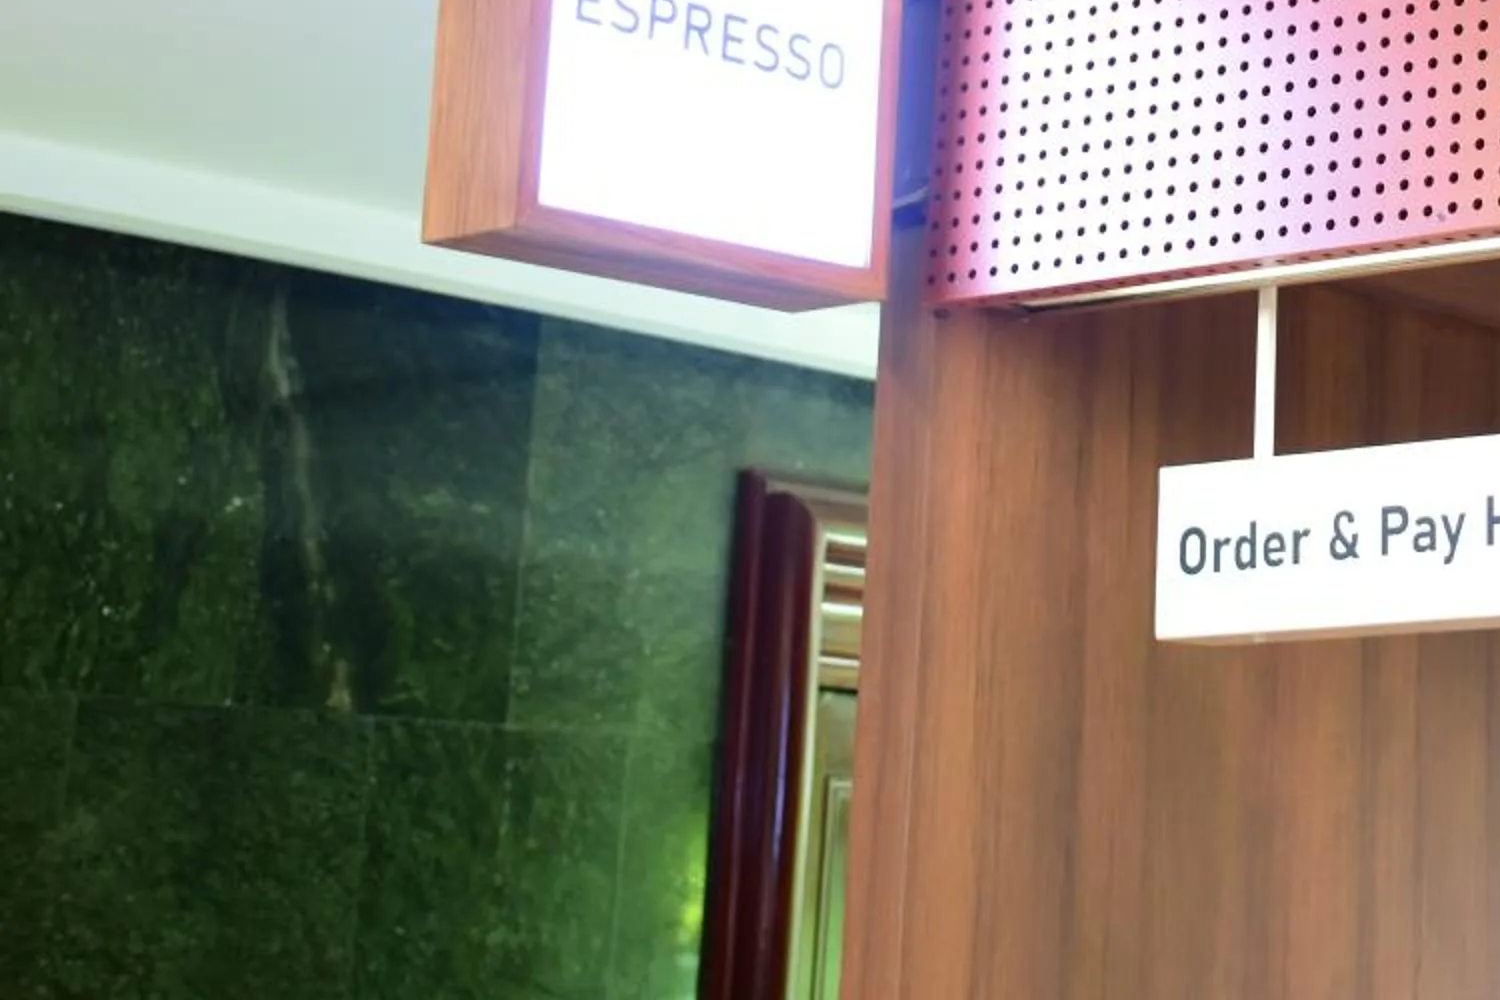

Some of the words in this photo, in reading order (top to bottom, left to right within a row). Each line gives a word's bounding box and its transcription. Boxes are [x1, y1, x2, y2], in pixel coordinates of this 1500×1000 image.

[1178, 520, 1311, 576] Order
[1328, 510, 1361, 561] &
[1380, 504, 1467, 565] Pay
